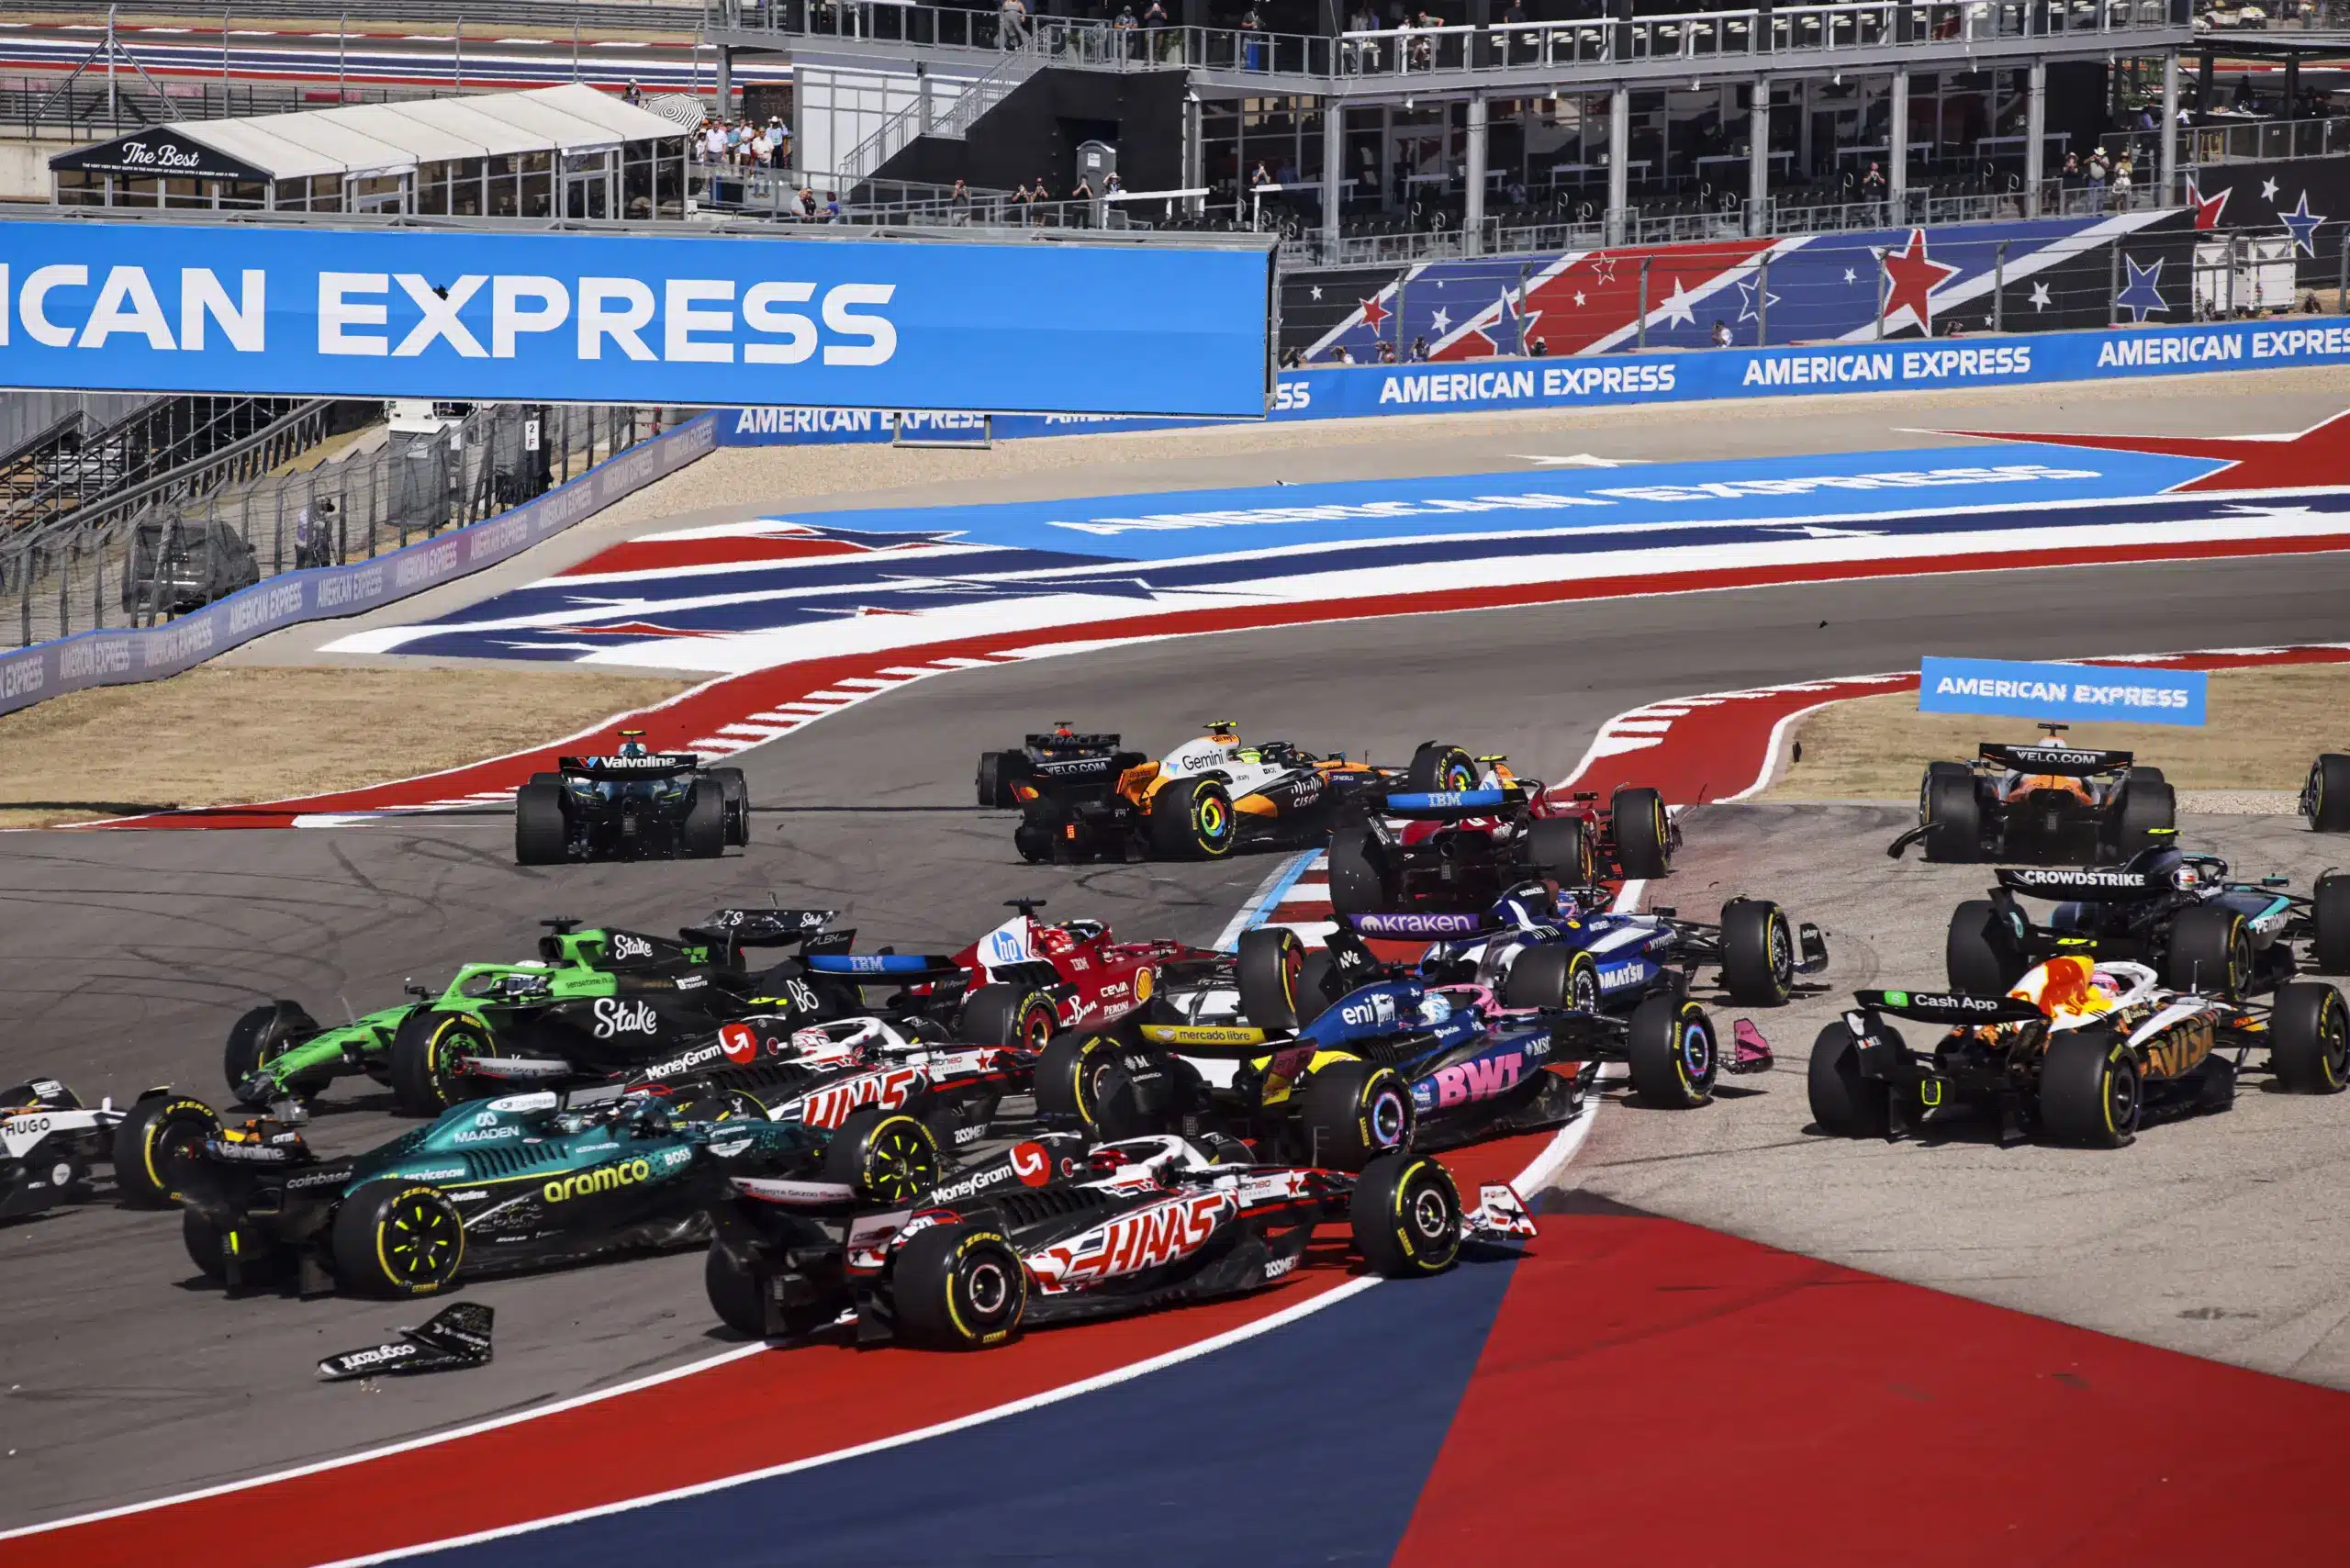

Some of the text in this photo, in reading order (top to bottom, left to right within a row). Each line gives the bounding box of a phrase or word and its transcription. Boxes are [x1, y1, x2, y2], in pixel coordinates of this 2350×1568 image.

[122, 141, 200, 167] The Best
[318, 271, 898, 367] EXPRESS
[2098, 334, 2244, 368] AMERICAN
[1742, 346, 2031, 386] AMERICAN EXPRESS
[1379, 364, 1676, 404] AMERICAN EXPRESS
[528, 423, 535, 434] 2
[735, 408, 872, 434] AMERICAN
[528, 438, 535, 447] F
[1936, 677, 2189, 708] AMERICAN EXPRESS
[600, 756, 677, 769] Valvoline
[1181, 748, 1225, 771] Gemini
[1427, 792, 1462, 808] IBM
[2023, 871, 2145, 887] CROWDSTRIKE
[1381, 913, 1472, 933] kraken
[613, 934, 653, 960] Stake
[998, 934, 1020, 963] hp
[849, 956, 886, 972] IBM
[1069, 956, 1091, 971] IBM
[1598, 961, 1644, 991] OMATSU
[1103, 1000, 1130, 1016] PERONI
[1341, 999, 1375, 1026] eni
[1914, 994, 1998, 1011] Cash App
[593, 997, 658, 1039] Stake
[1179, 1030, 1251, 1041] mercado libre
[1534, 1036, 1552, 1056] MSC
[645, 1043, 722, 1081] MoneyGram
[1432, 1051, 1523, 1109] BWT
[176, 1100, 214, 1117] ZERO
[5, 1116, 51, 1137] HUGO
[453, 1126, 520, 1144] MAADEN
[217, 1140, 286, 1160] Valvoline
[664, 1147, 692, 1167] BOSS
[285, 1170, 352, 1190] coinbase
[543, 1159, 650, 1204] aramco
[931, 1163, 1013, 1205] MoneyGram
[965, 1232, 1002, 1247] ZERO
[338, 1343, 417, 1370] cognizant
